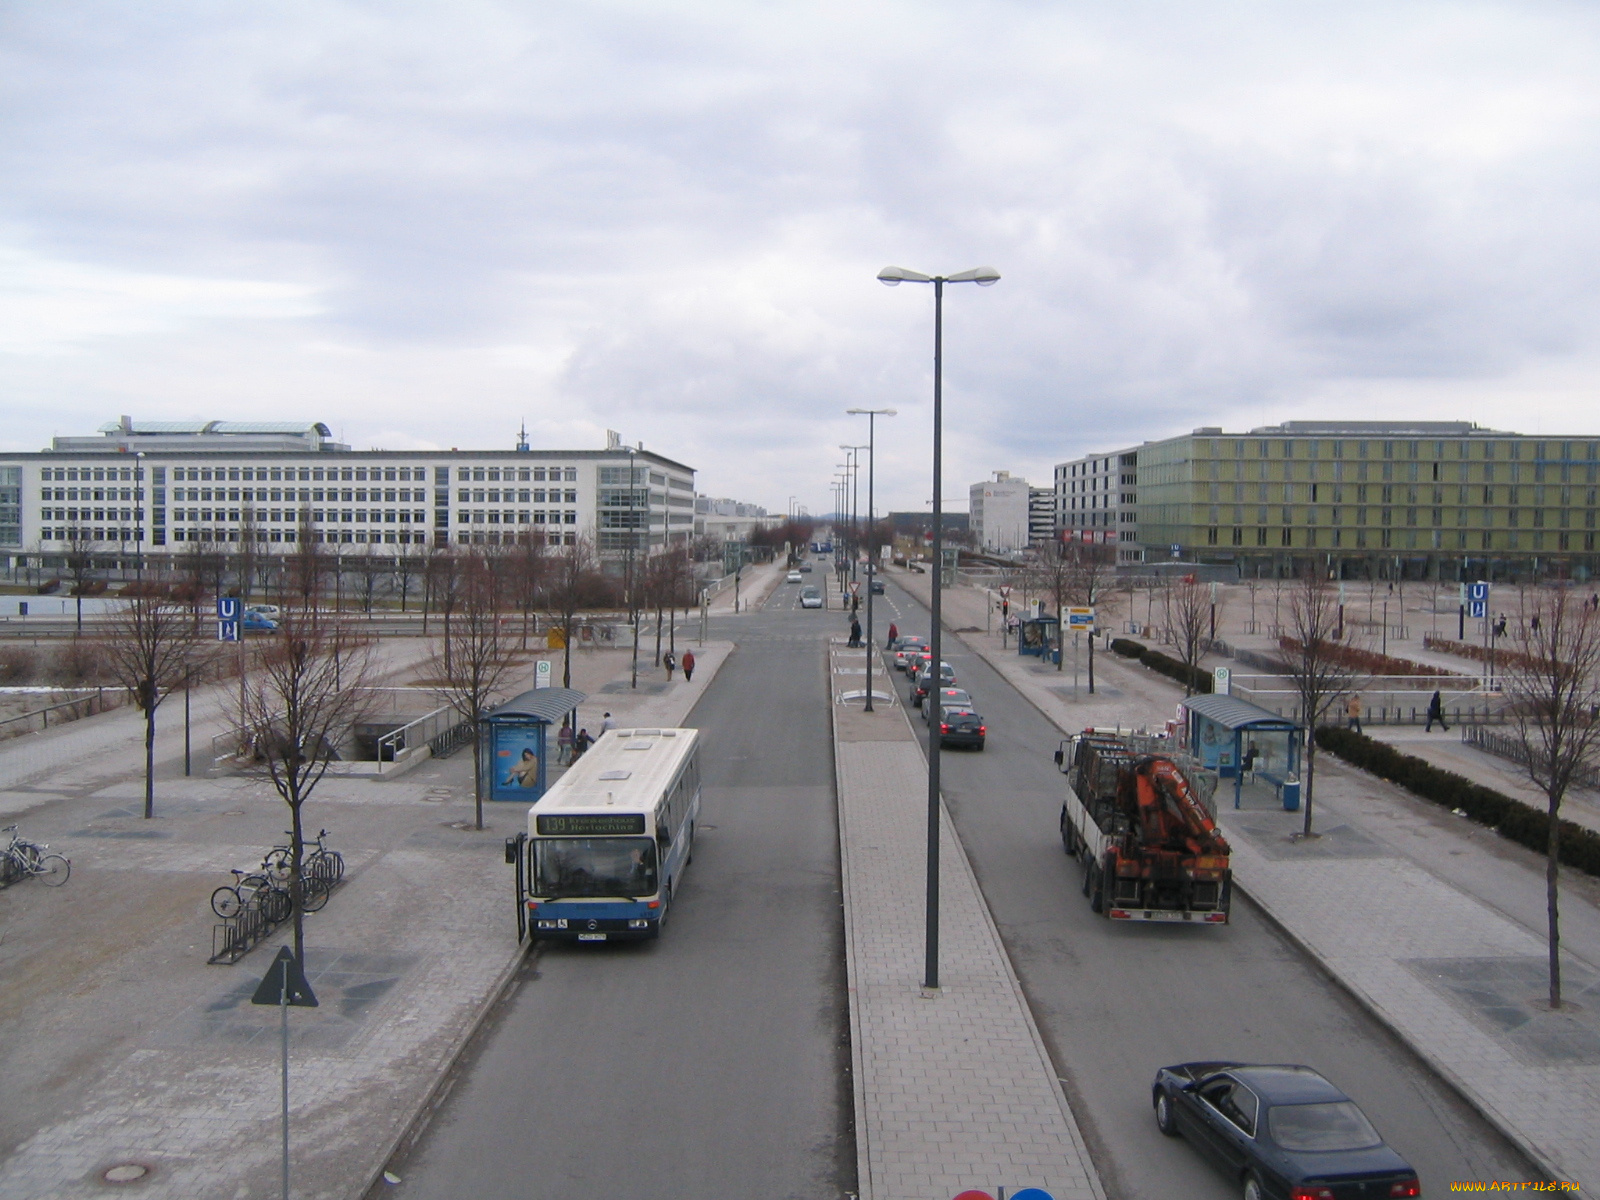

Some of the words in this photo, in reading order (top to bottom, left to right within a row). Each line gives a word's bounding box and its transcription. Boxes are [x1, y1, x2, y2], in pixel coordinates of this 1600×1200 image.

[1473, 585, 1484, 599] U
[221, 600, 235, 617] U
[545, 817, 566, 831] 139
